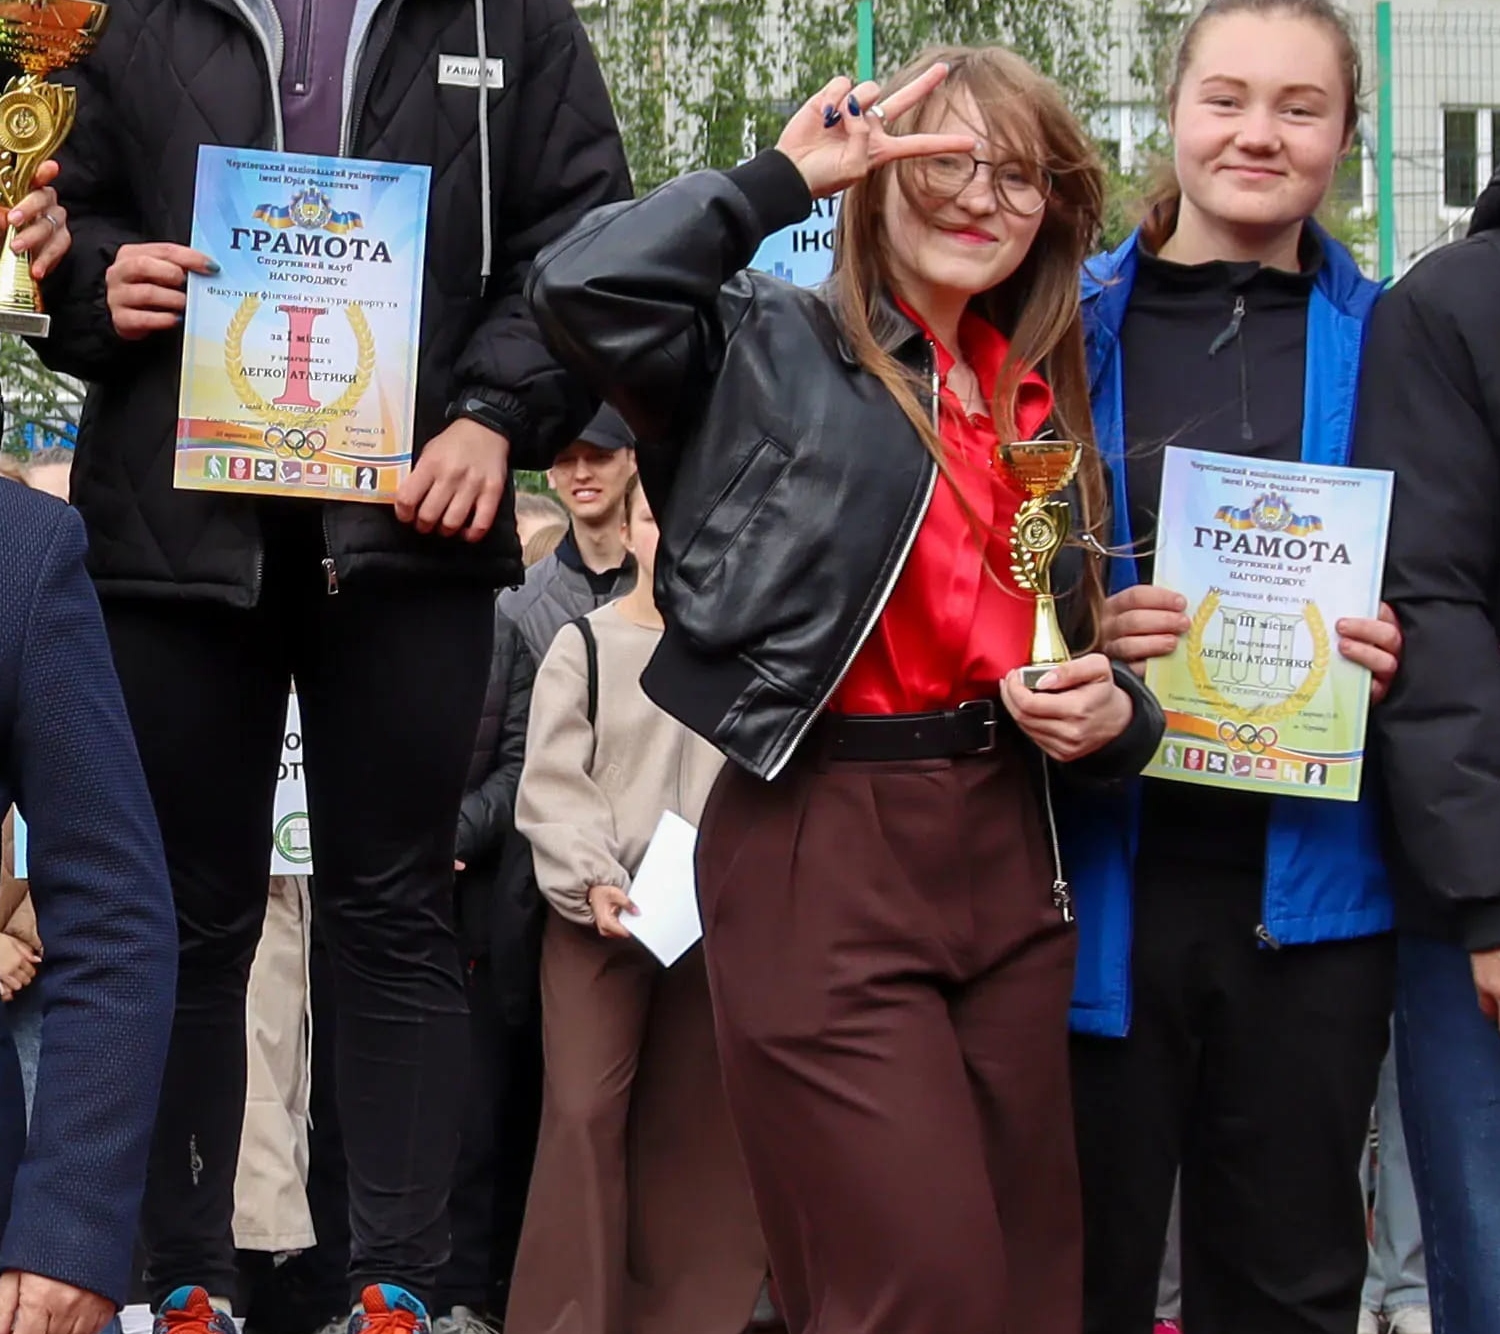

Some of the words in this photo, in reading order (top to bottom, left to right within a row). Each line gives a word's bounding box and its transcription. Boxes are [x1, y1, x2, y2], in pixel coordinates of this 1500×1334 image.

[230, 227, 392, 263] ГРАМОТА
[257, 256, 324, 270] Спортивний
[327, 263, 353, 272] клуб
[296, 335, 331, 345] місце
[240, 367, 286, 379] ЛЕГКОЇ
[290, 370, 357, 384] АТЛЕТИКИ
[1193, 526, 1352, 565] ГРАМОТА
